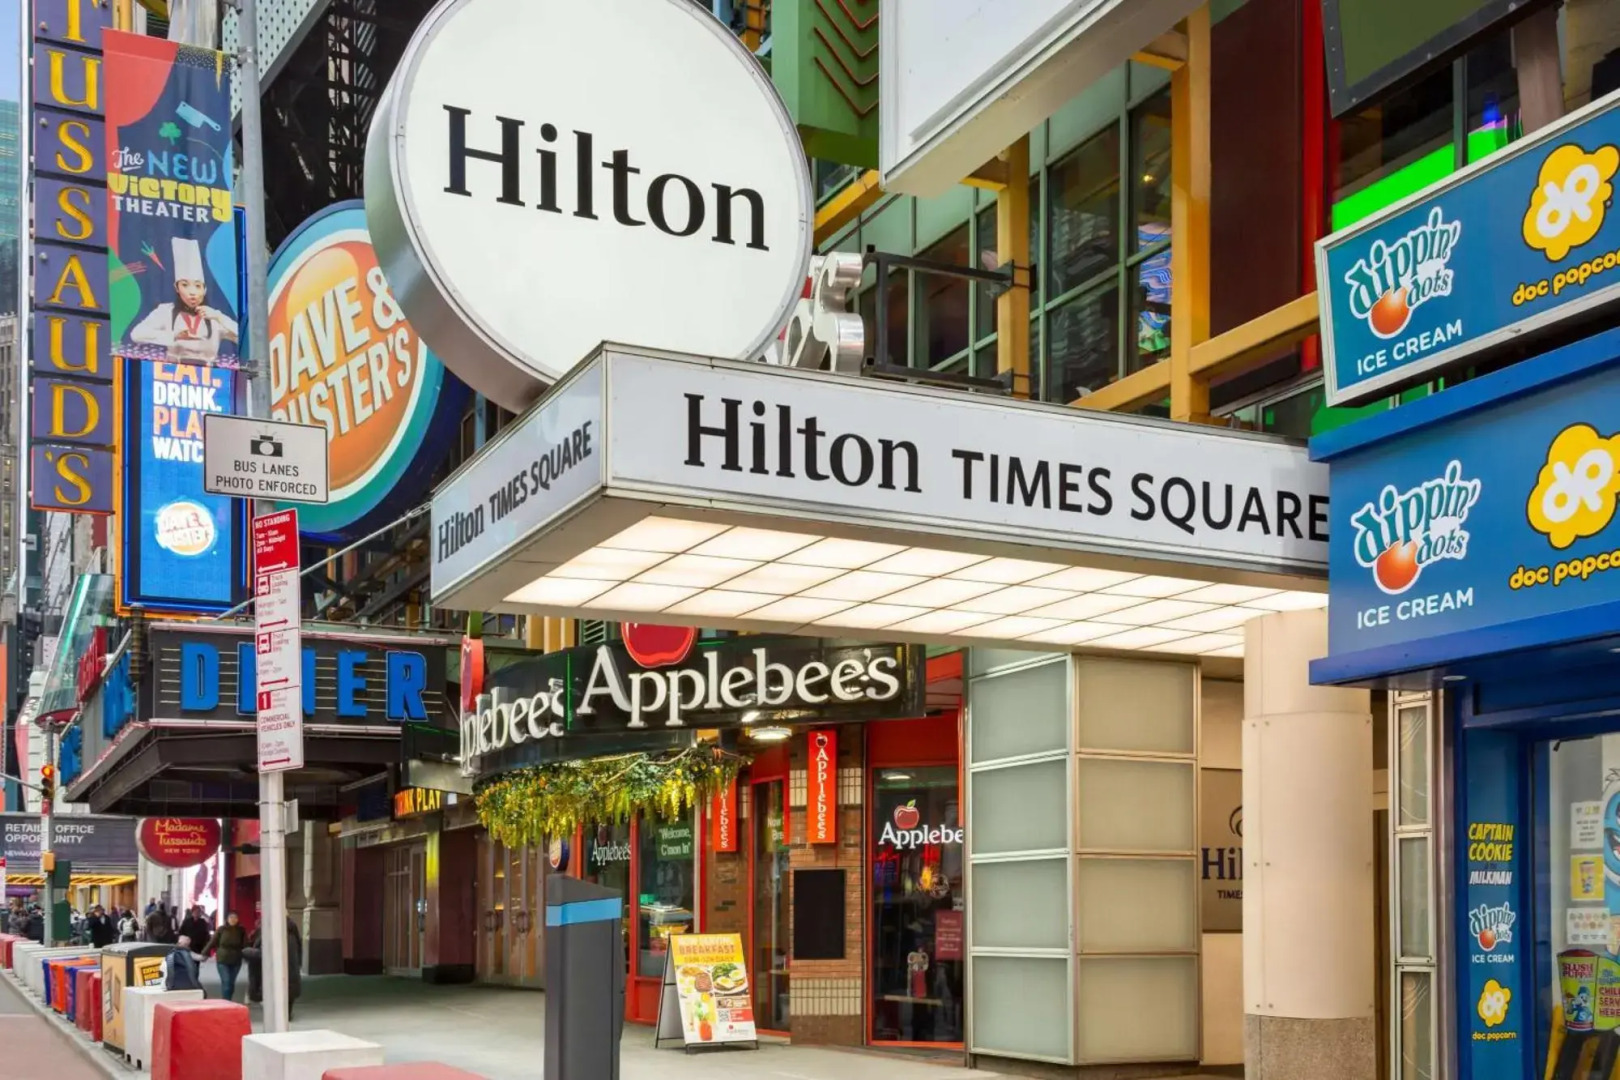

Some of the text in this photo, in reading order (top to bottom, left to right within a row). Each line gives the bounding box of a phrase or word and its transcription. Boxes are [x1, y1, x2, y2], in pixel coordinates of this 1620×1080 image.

[112, 146, 217, 185] The NEW
[443, 104, 770, 252] Hilton
[112, 195, 209, 223] THEATER
[1346, 208, 1461, 318] dippin'
[1407, 268, 1453, 308] dots
[1512, 281, 1549, 307] doc
[270, 266, 406, 406] DAVE &
[1357, 319, 1463, 376] ICE CREAM
[153, 361, 223, 388] EAT.
[153, 381, 223, 412] DRINK.
[153, 406, 207, 440] PLA
[153, 437, 204, 464] WATC
[234, 460, 299, 477] BUS LANES
[683, 393, 1330, 543] Hilton TIMES SQUARE
[215, 475, 317, 496] PHOTO ENFORCED
[438, 420, 592, 563] Hilton TIMES SQUARE
[263, 514, 290, 527] STANDING
[1351, 460, 1481, 567] dippin'
[1416, 530, 1467, 564] dots
[1509, 565, 1550, 590] doc
[1357, 587, 1474, 629] ICE CREAM
[576, 644, 900, 728] Applebee's
[5, 823, 94, 834] RETAIL OFFICE
[155, 818, 207, 833] Madame
[772, 829, 784, 841] Bre
[878, 821, 963, 850] Applebe
[1468, 822, 1514, 841] CAPTAIN
[155, 832, 207, 846] Tussauds
[1469, 842, 1513, 861] COOKIE
[4, 850, 41, 858] NEWMAR
[1470, 871, 1512, 885] MILKMAN
[1217, 889, 1242, 900] TIME
[679, 944, 735, 955] BREAKFAST
[1471, 954, 1514, 963] ICE CREAM
[1563, 963, 1594, 971] SLUSH
[1472, 1031, 1516, 1042] doc popcorn
